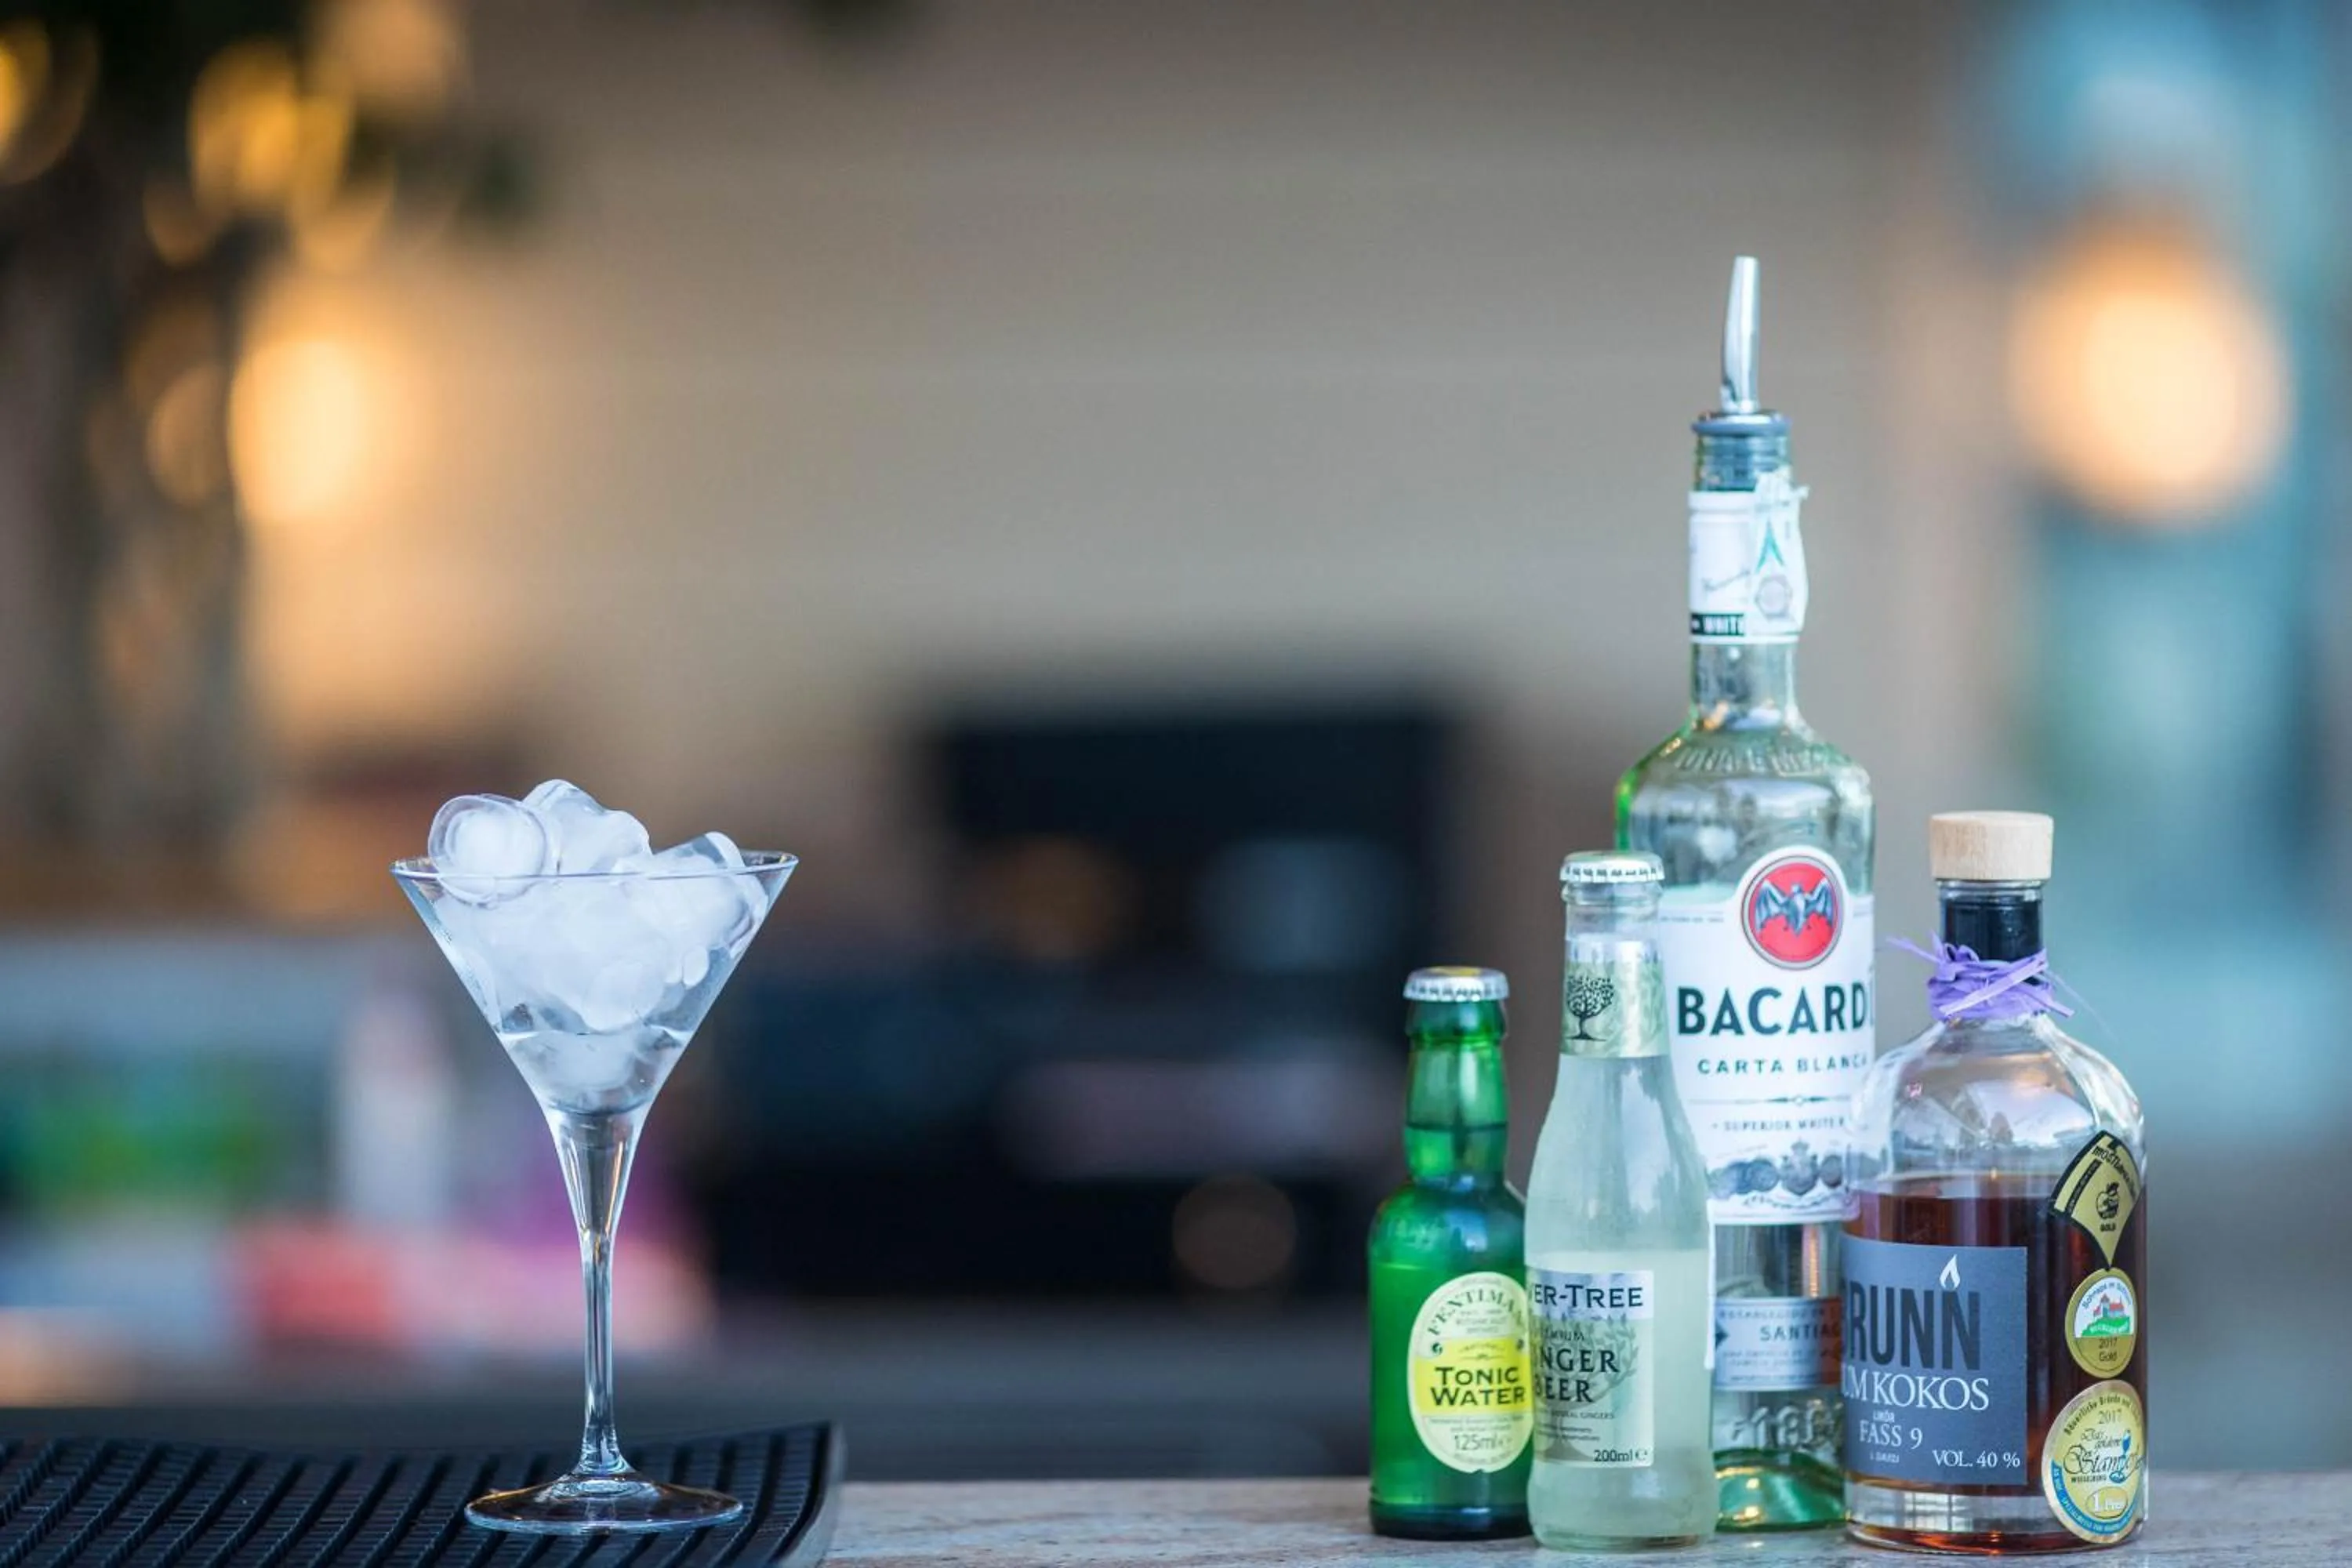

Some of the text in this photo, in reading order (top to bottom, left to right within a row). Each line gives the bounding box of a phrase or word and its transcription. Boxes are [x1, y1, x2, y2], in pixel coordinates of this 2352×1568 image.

[1697, 1058, 1784, 1075] CARTA
[1841, 1280, 1980, 1371] RUNN
[1538, 1347, 1620, 1372] NGER
[1434, 1367, 1519, 1385] TONIC
[1430, 1385, 1525, 1406] WATER
[1872, 1371, 1989, 1411] KOKOS
[1859, 1419, 1923, 1449] FASS 9
[1594, 1449, 1633, 1462] 200ml
[1932, 1449, 2021, 1468] VOL. 40 %
